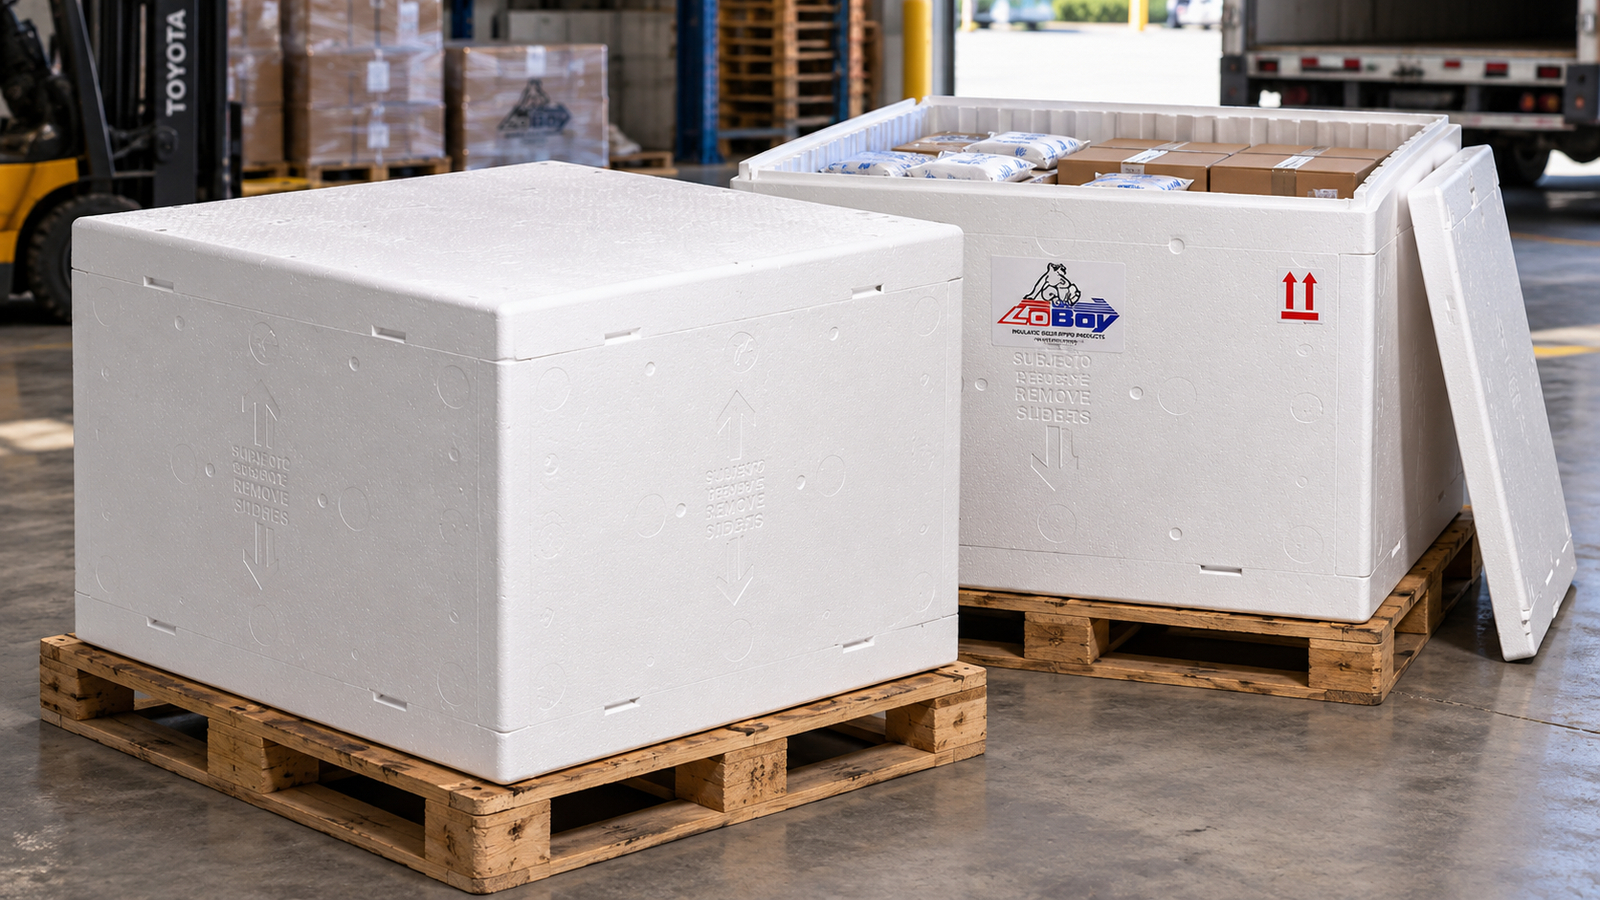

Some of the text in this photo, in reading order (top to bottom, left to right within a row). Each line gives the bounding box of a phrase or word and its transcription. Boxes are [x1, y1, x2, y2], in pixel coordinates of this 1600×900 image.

[165, 8, 187, 117] TOYOTA
[1015, 385, 1091, 405] REMOVE
[233, 477, 290, 508] REMOVE
